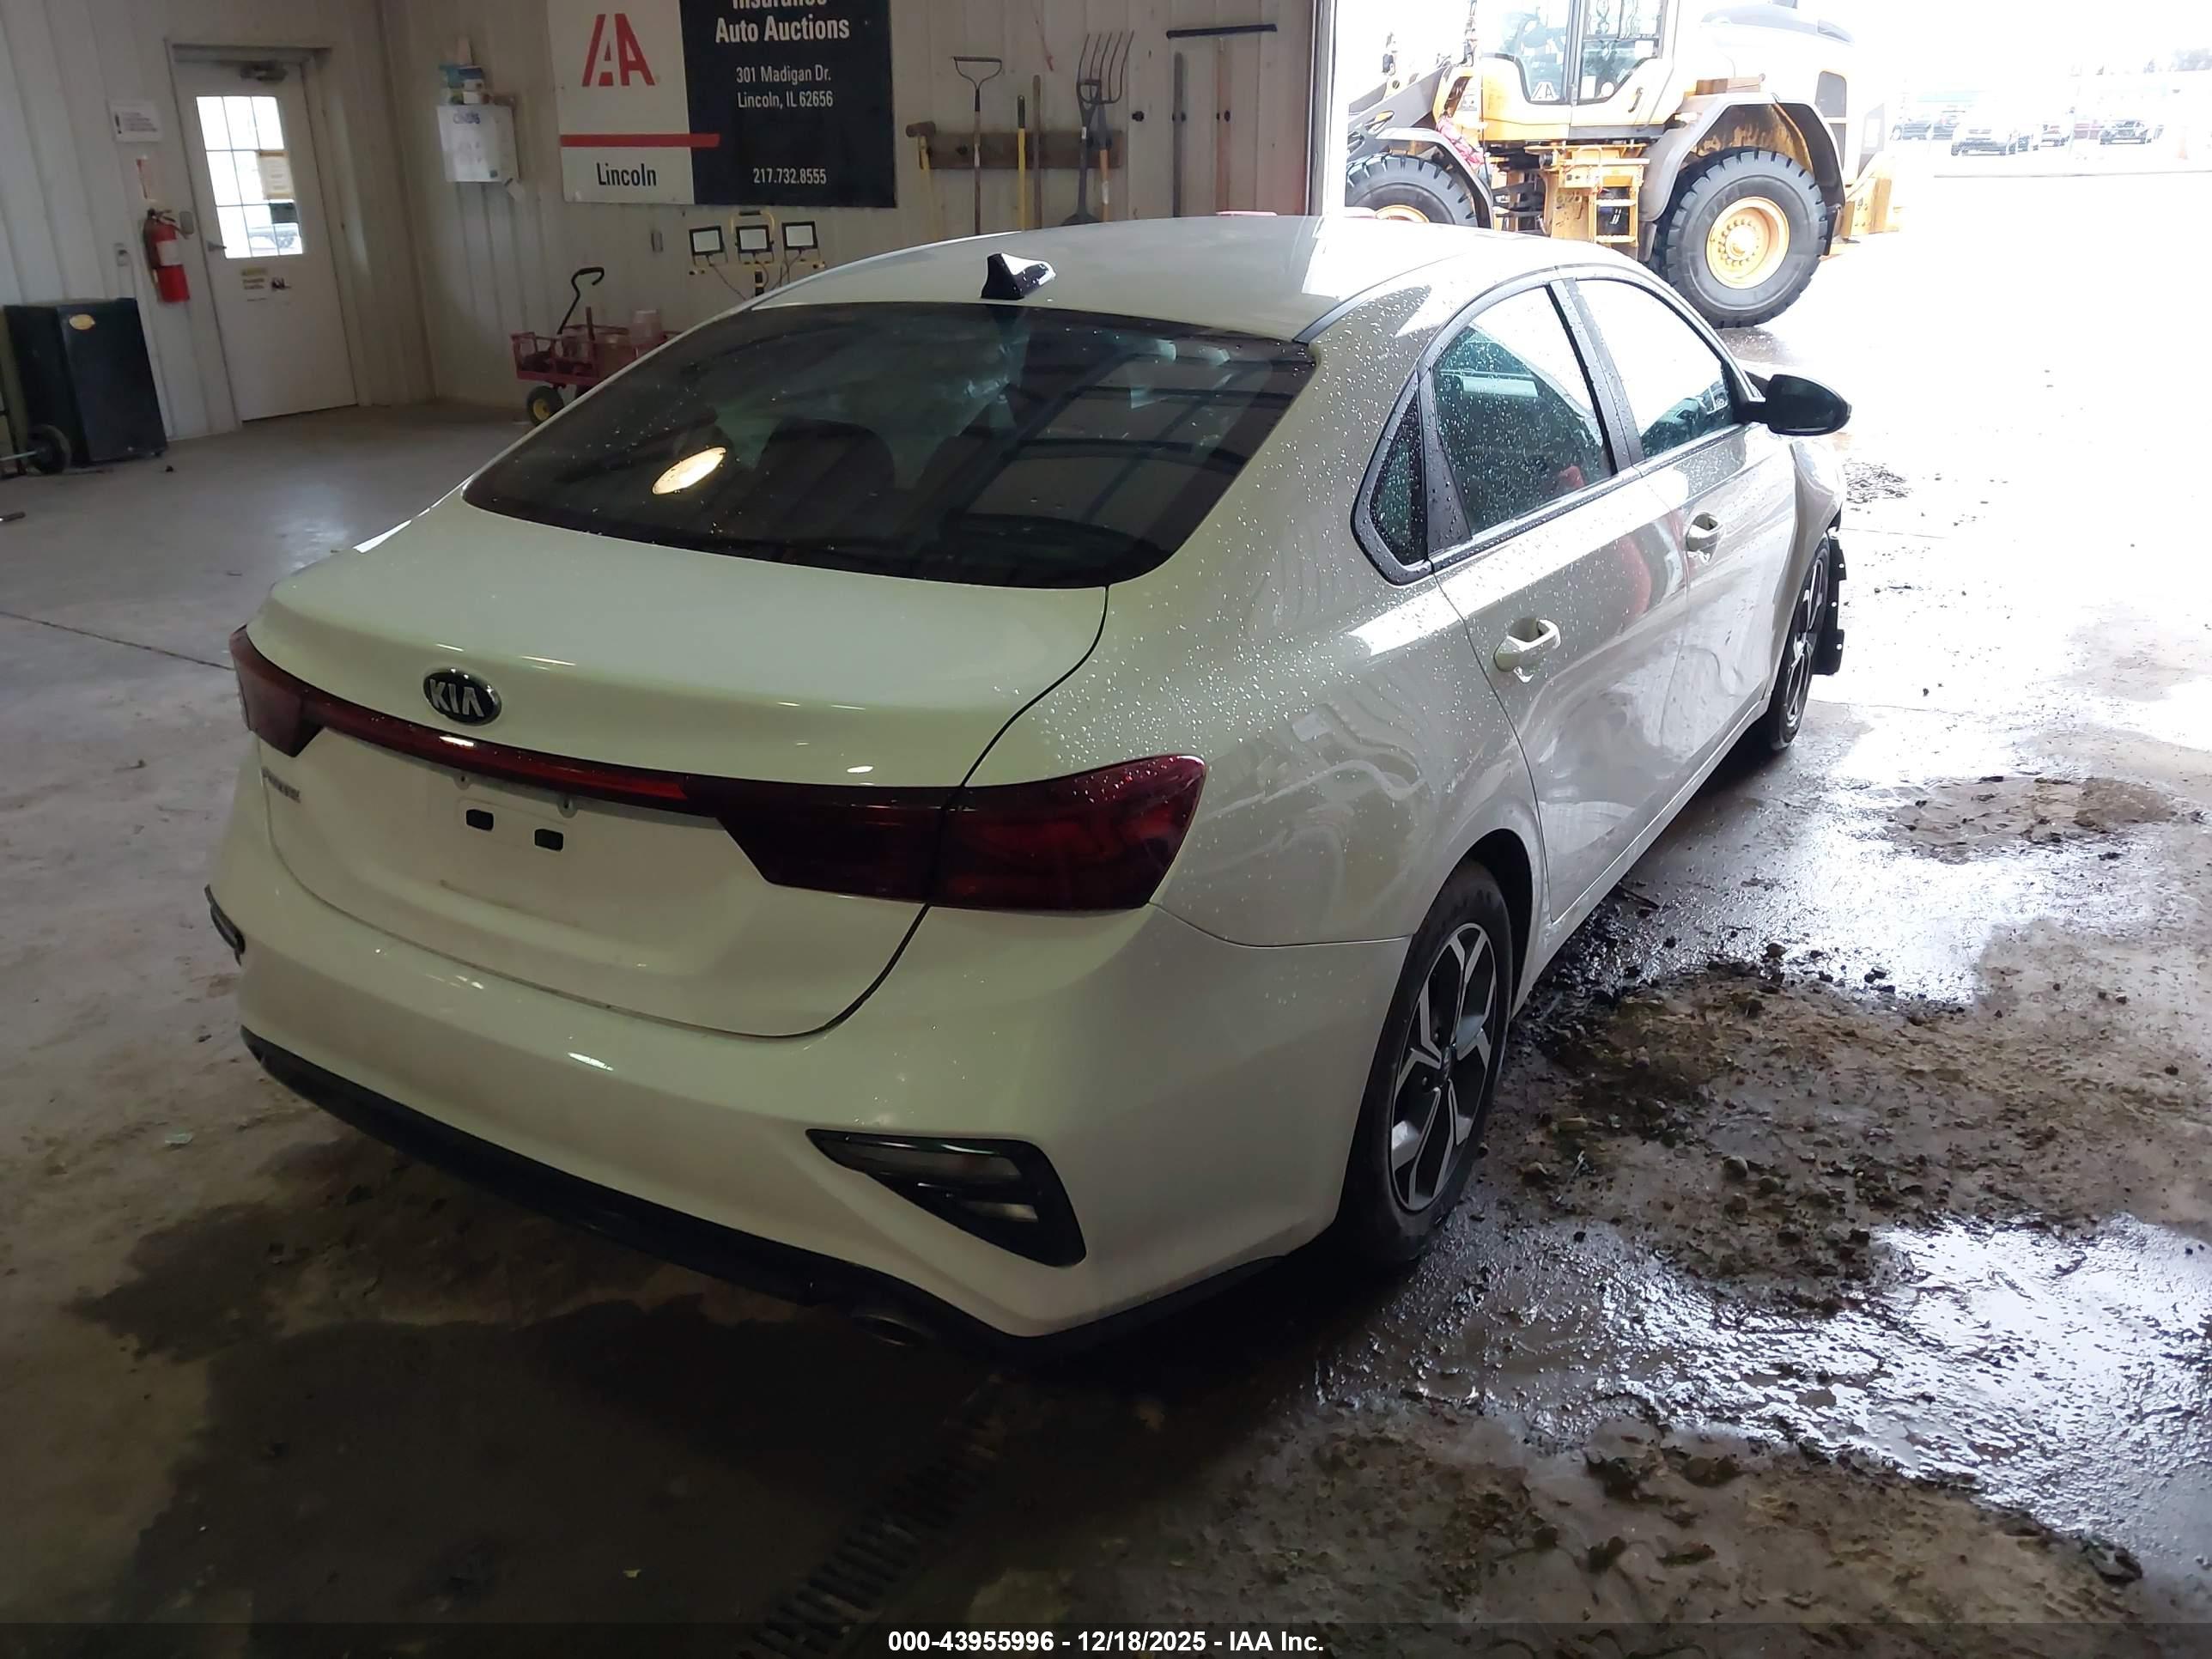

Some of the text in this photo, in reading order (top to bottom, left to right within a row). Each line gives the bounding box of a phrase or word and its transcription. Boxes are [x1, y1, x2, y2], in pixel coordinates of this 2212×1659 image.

[715, 14, 850, 43] Auto Auctions
[736, 64, 831, 85] 301 Madigan Dr.
[738, 90, 833, 109] Lincoln, IL 62656
[596, 163, 657, 187] Lincoln
[753, 168, 827, 185] 217.732.8555
[429, 678, 484, 717] KIA
